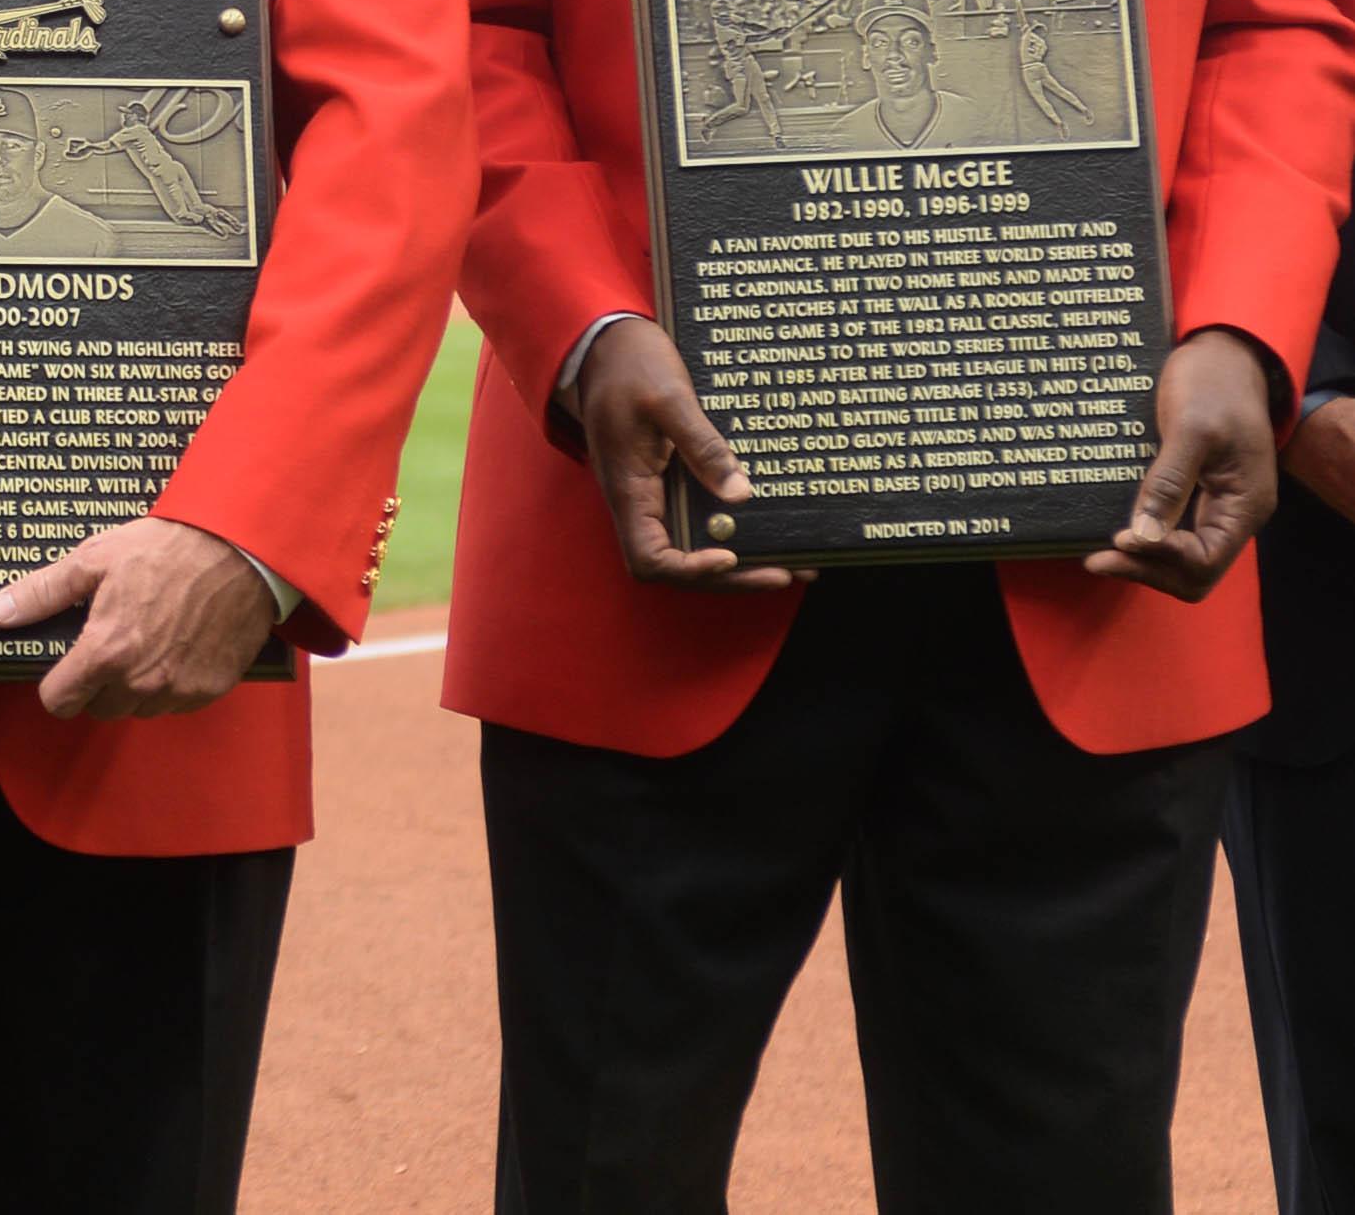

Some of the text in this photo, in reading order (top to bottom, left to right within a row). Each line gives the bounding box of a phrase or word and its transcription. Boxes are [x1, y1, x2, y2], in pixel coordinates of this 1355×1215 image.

[800, 159, 1013, 194] WILLIE McGEE
[918, 192, 1030, 215] 1996-1999
[821, 254, 844, 270] HE
[846, 252, 907, 269] PLAYED
[908, 251, 928, 266] IN
[931, 248, 981, 265] THREE
[982, 246, 1044, 263] WORLD
[1046, 243, 1097, 260] SERIES
[1099, 242, 1134, 258] FOR
[710, 325, 774, 343] DURING
[777, 322, 825, 340] GAME
[829, 321, 839, 337] 3
[842, 320, 866, 337] OF
[868, 319, 901, 335] THE
[905, 317, 945, 333] 1982
[947, 315, 986, 332] FALL
[1060, 308, 1131, 327] HELPING
[17, 339, 72, 356] SWING
[76, 340, 112, 356] AND
[116, 340, 244, 357] HIGHLIGHT-REEL
[43, 362, 85, 378] WON
[90, 363, 115, 379] SIX
[119, 363, 202, 379] RAWLINGS
[712, 370, 749, 387] MVP
[752, 370, 771, 385] IN
[776, 368, 815, 384] 1985
[819, 365, 868, 382] AFTER
[870, 364, 893, 380] HE
[895, 362, 927, 379] LED
[928, 361, 961, 377] THE
[963, 358, 1025, 376] LEAGUE
[1027, 357, 1048, 373] IN
[1050, 355, 1087, 372] HITS
[48, 640, 66, 655] IN
